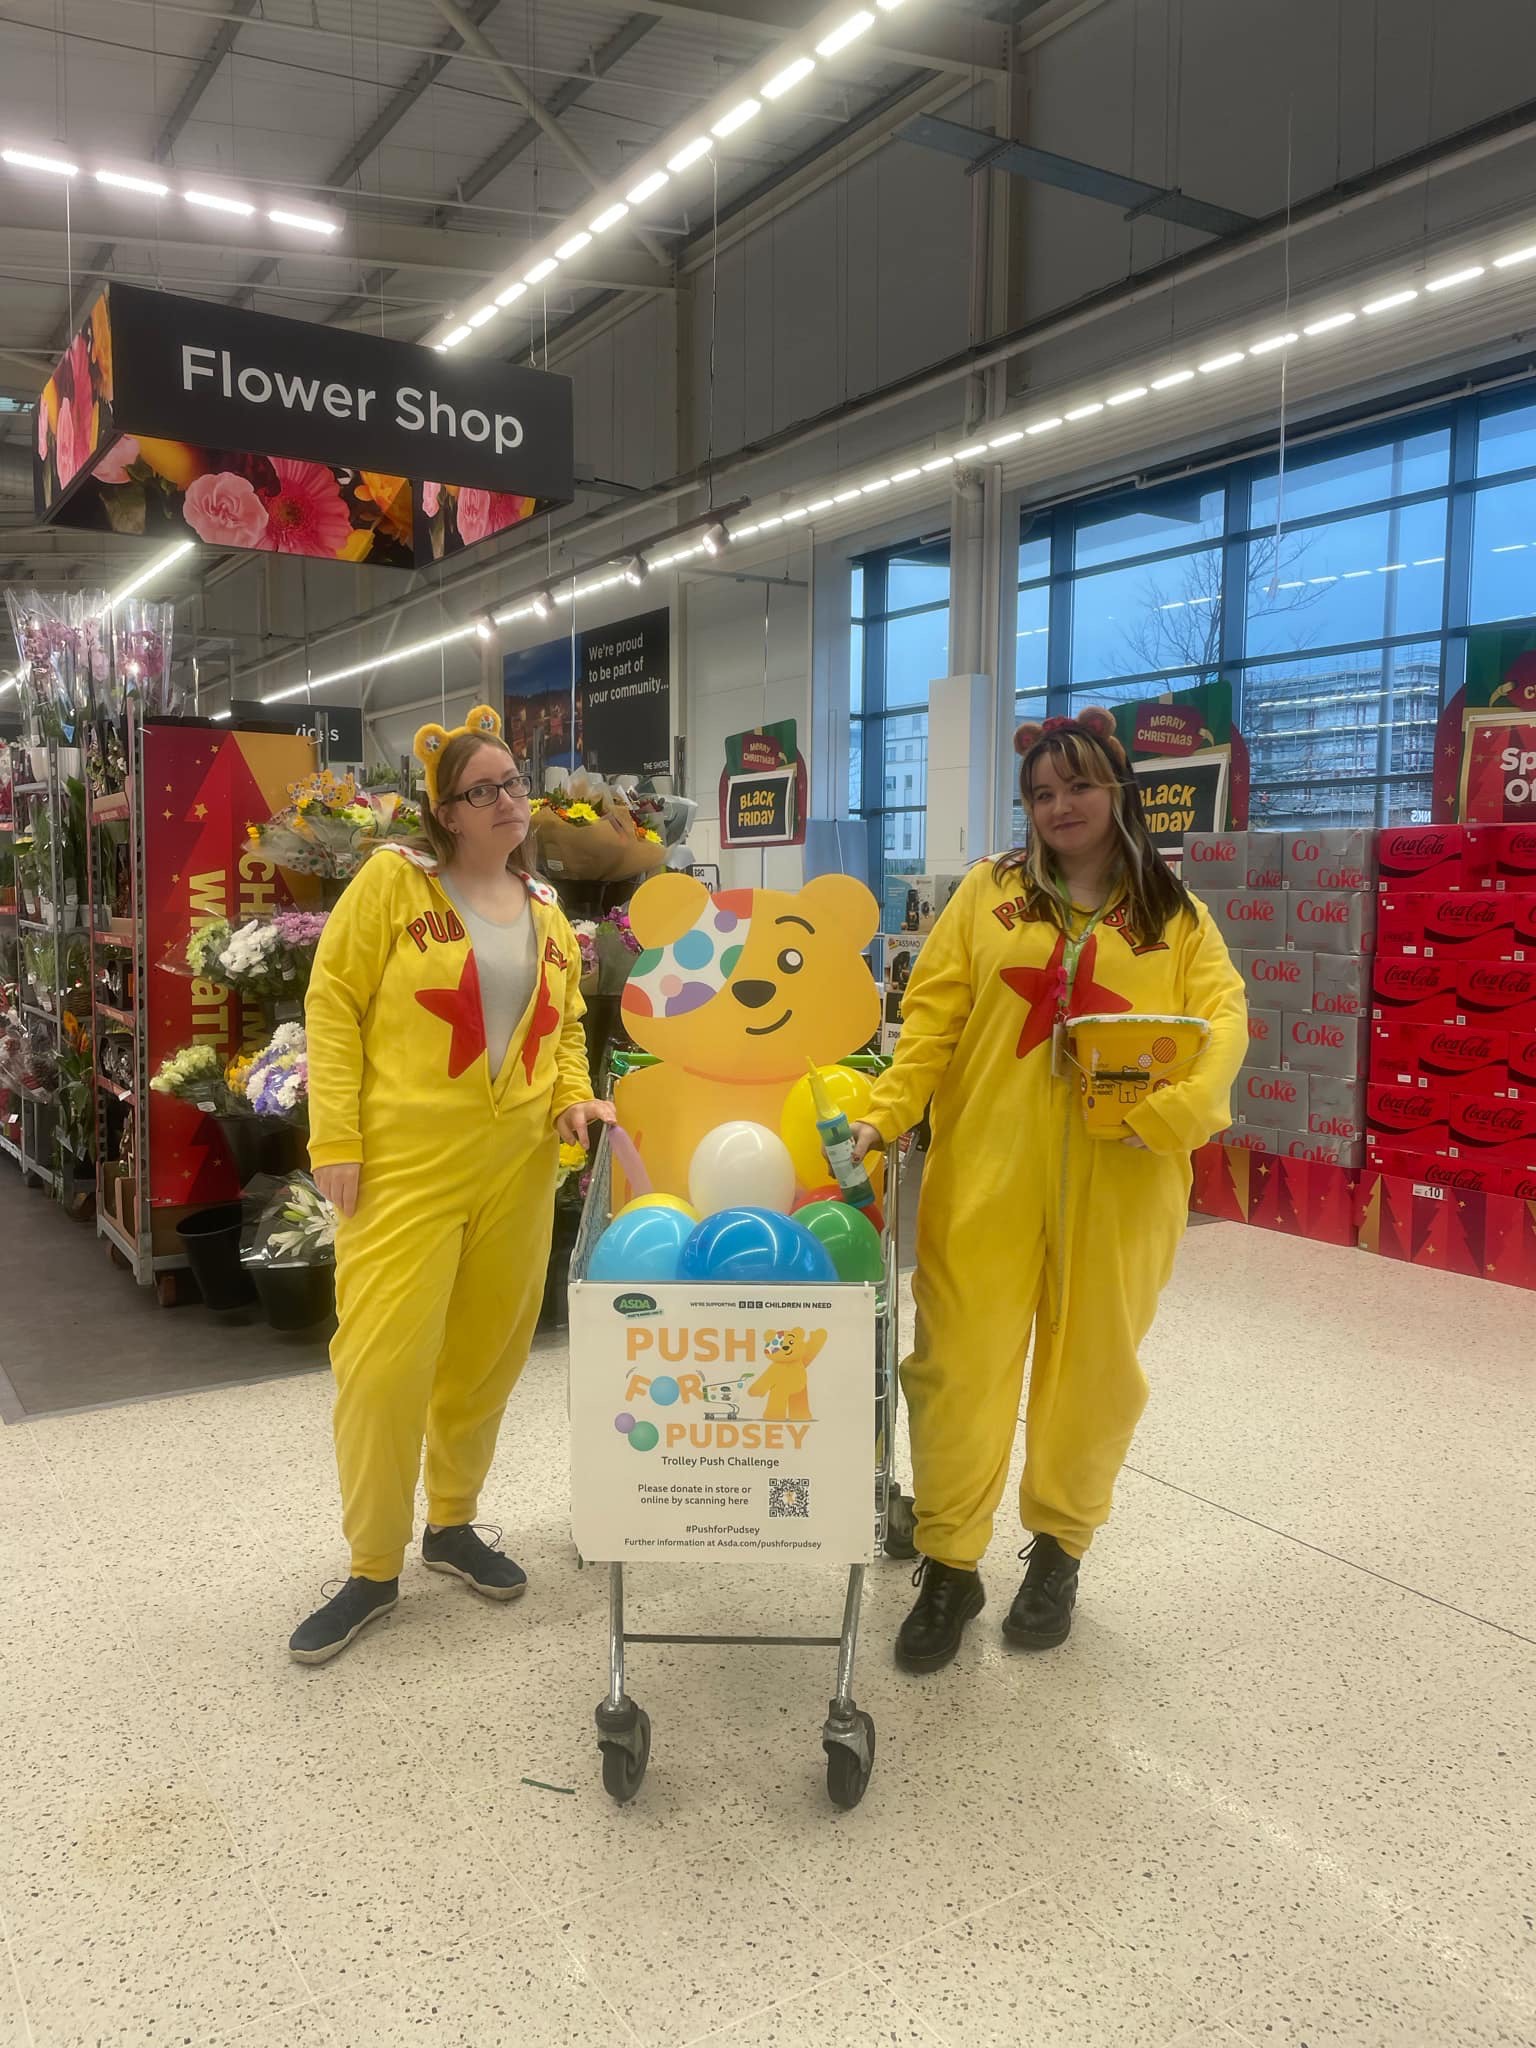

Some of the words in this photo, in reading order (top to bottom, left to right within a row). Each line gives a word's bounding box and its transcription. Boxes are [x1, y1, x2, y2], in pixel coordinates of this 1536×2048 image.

[182, 344, 376, 421] Flower
[395, 386, 524, 454] Shop
[589, 643, 614, 660] We're
[616, 632, 644, 656] proud
[589, 669, 598, 682] to
[600, 665, 611, 680] be
[613, 659, 632, 680] part
[633, 655, 644, 673] of
[589, 690, 609, 707] your
[610, 676, 669, 700] community...
[1191, 841, 1237, 862] Coke
[1247, 868, 1281, 888] Coke
[1317, 868, 1364, 888] Coke
[1226, 899, 1275, 921] Coke
[1297, 900, 1350, 923] Coke
[1252, 959, 1301, 982] Coke
[1313, 992, 1358, 1014] Coke
[1248, 1018, 1269, 1040] ke
[1292, 1022, 1345, 1048] Coke
[1248, 1076, 1296, 1103] Coke
[1309, 1113, 1353, 1138] Coke
[619, 1298, 651, 1309] ASDA
[765, 1301, 801, 1309] CHILDREN
[626, 1328, 756, 1362] PUSH
[625, 1374, 704, 1407] FOR
[666, 1423, 810, 1450] PUDSEY
[662, 1456, 697, 1467] Trolley
[699, 1456, 725, 1466] Push
[727, 1456, 780, 1468] Challenge
[638, 1484, 668, 1494] Please
[670, 1484, 702, 1494] donate
[704, 1484, 714, 1493] in
[715, 1485, 739, 1494] store
[741, 1486, 751, 1494] or
[640, 1495, 669, 1504] online
[671, 1496, 683, 1506] by
[685, 1496, 726, 1507] scanning
[728, 1496, 749, 1505] here
[686, 1525, 760, 1535] #PushforPudsey
[624, 1538, 655, 1547] Further
[657, 1538, 705, 1547] information
[707, 1539, 715, 1547] at
[717, 1539, 822, 1550] Asda.com/pushforpudsey
